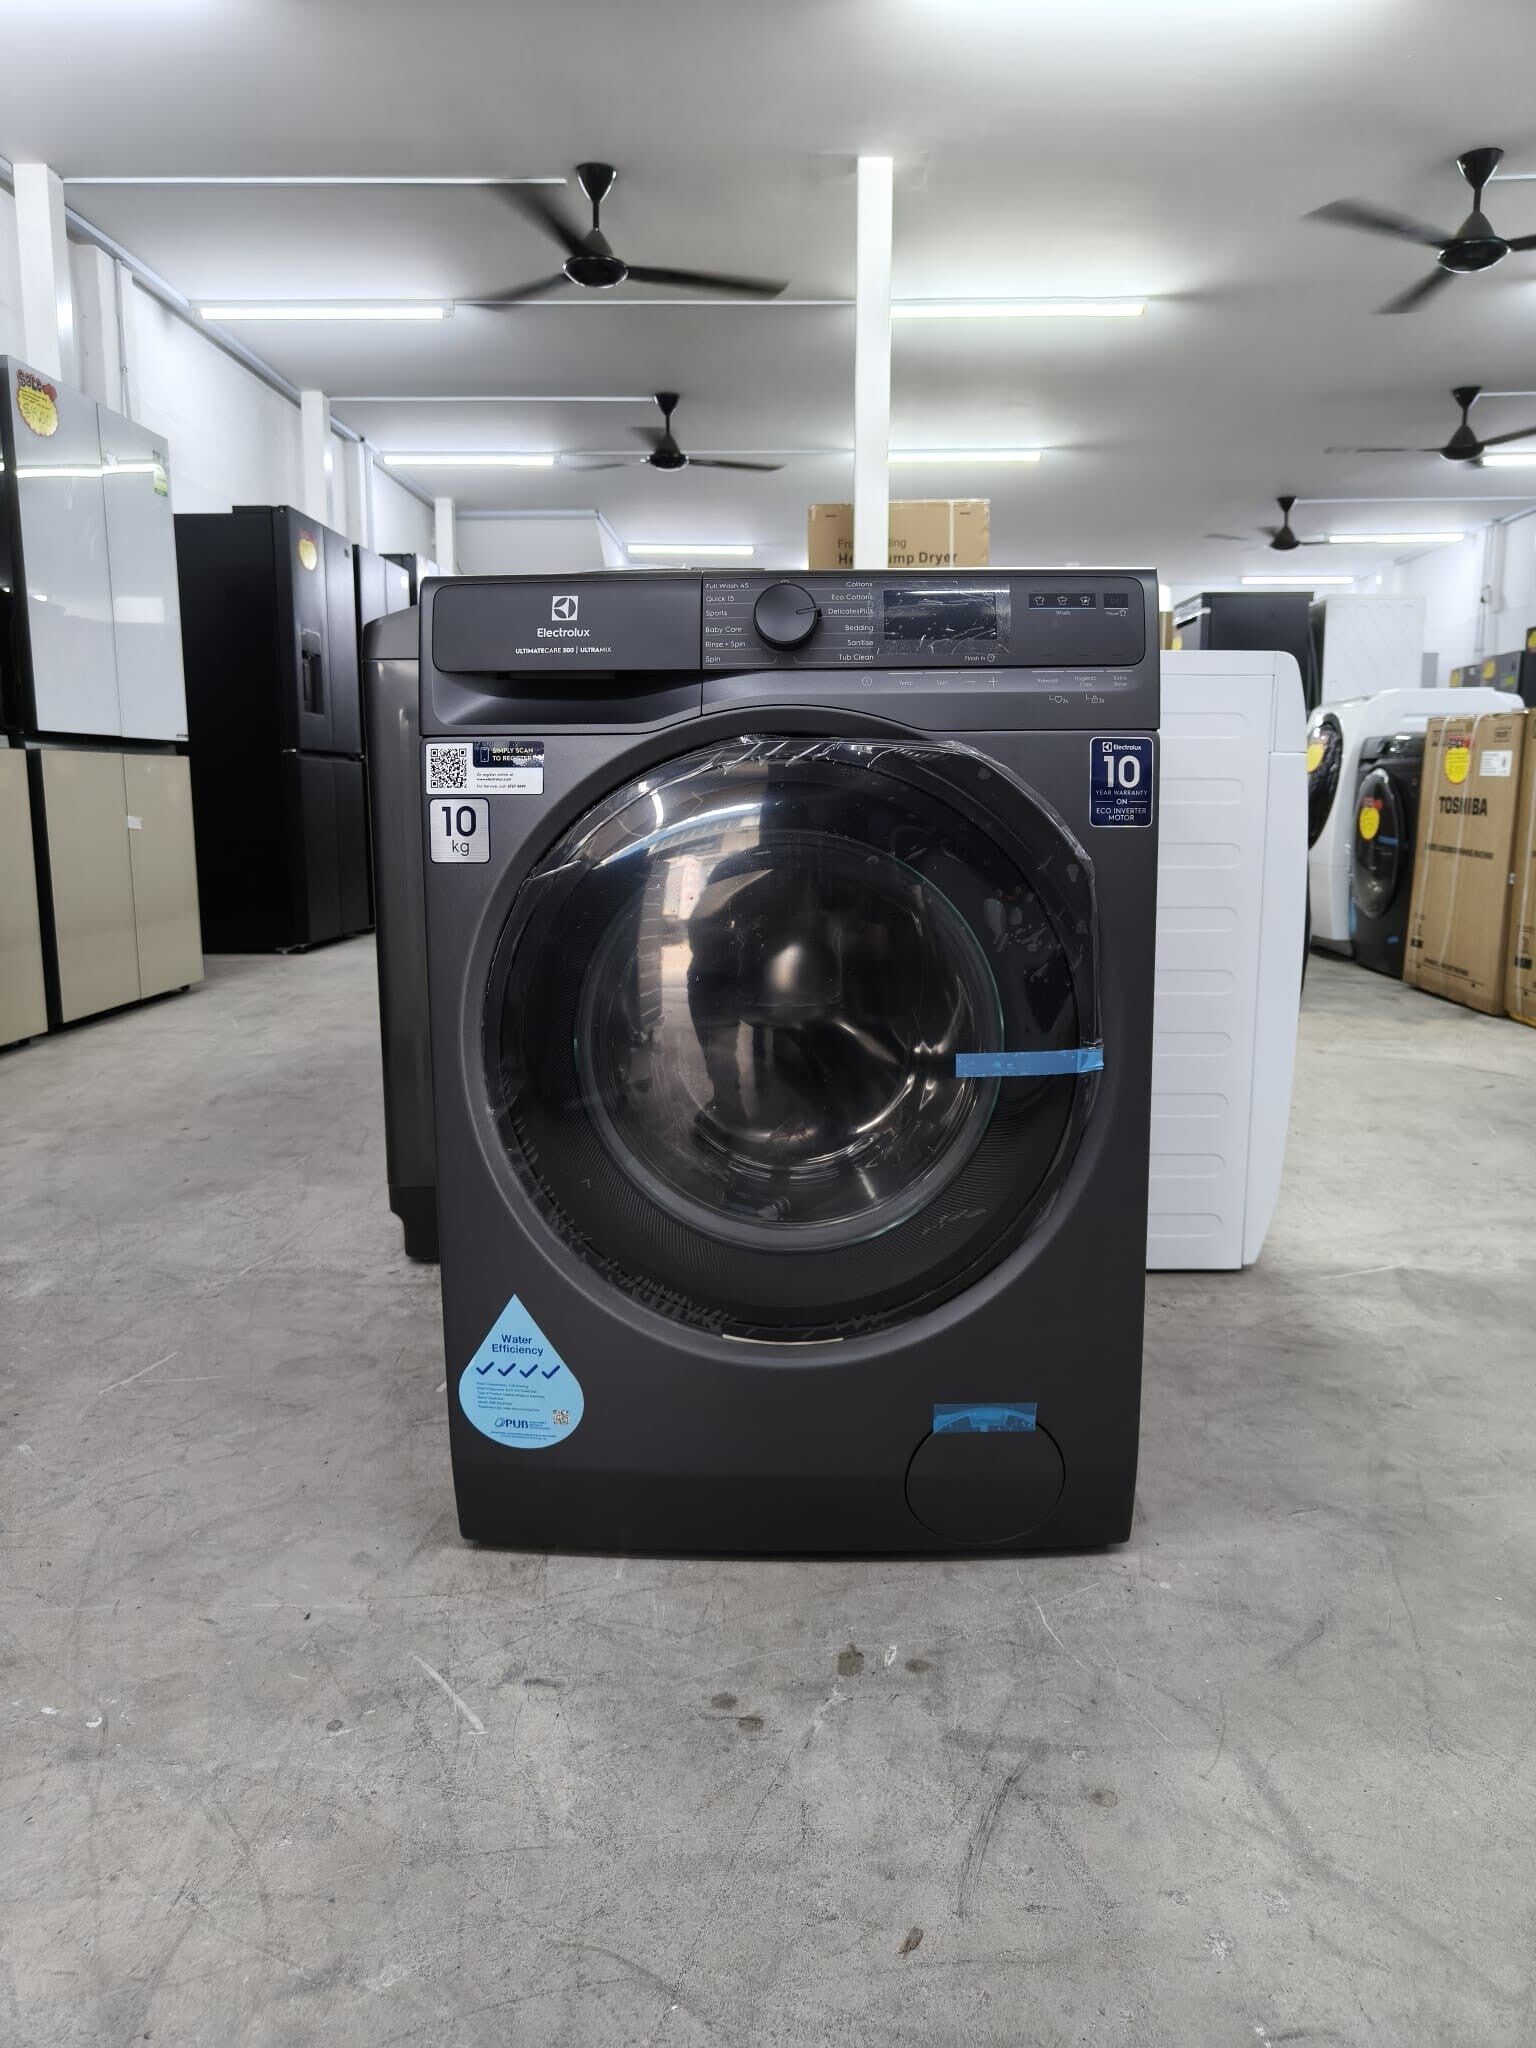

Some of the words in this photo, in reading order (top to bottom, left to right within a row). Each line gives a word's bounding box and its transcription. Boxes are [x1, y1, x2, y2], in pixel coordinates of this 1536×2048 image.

[919, 552, 957, 565] Dryer
[537, 627, 590, 638] Electrolux
[844, 624, 874, 633] Bedding
[730, 641, 746, 649] Spin
[705, 655, 721, 663] Spin
[853, 653, 874, 661] Clean
[1103, 755, 1140, 788] 10
[1439, 796, 1488, 816] TOSHIBA
[441, 806, 477, 837] 10
[452, 840, 470, 856] kg
[501, 1334, 533, 1345] Water
[491, 1343, 544, 1357] Efficiency
[505, 1419, 529, 1429] PUB
